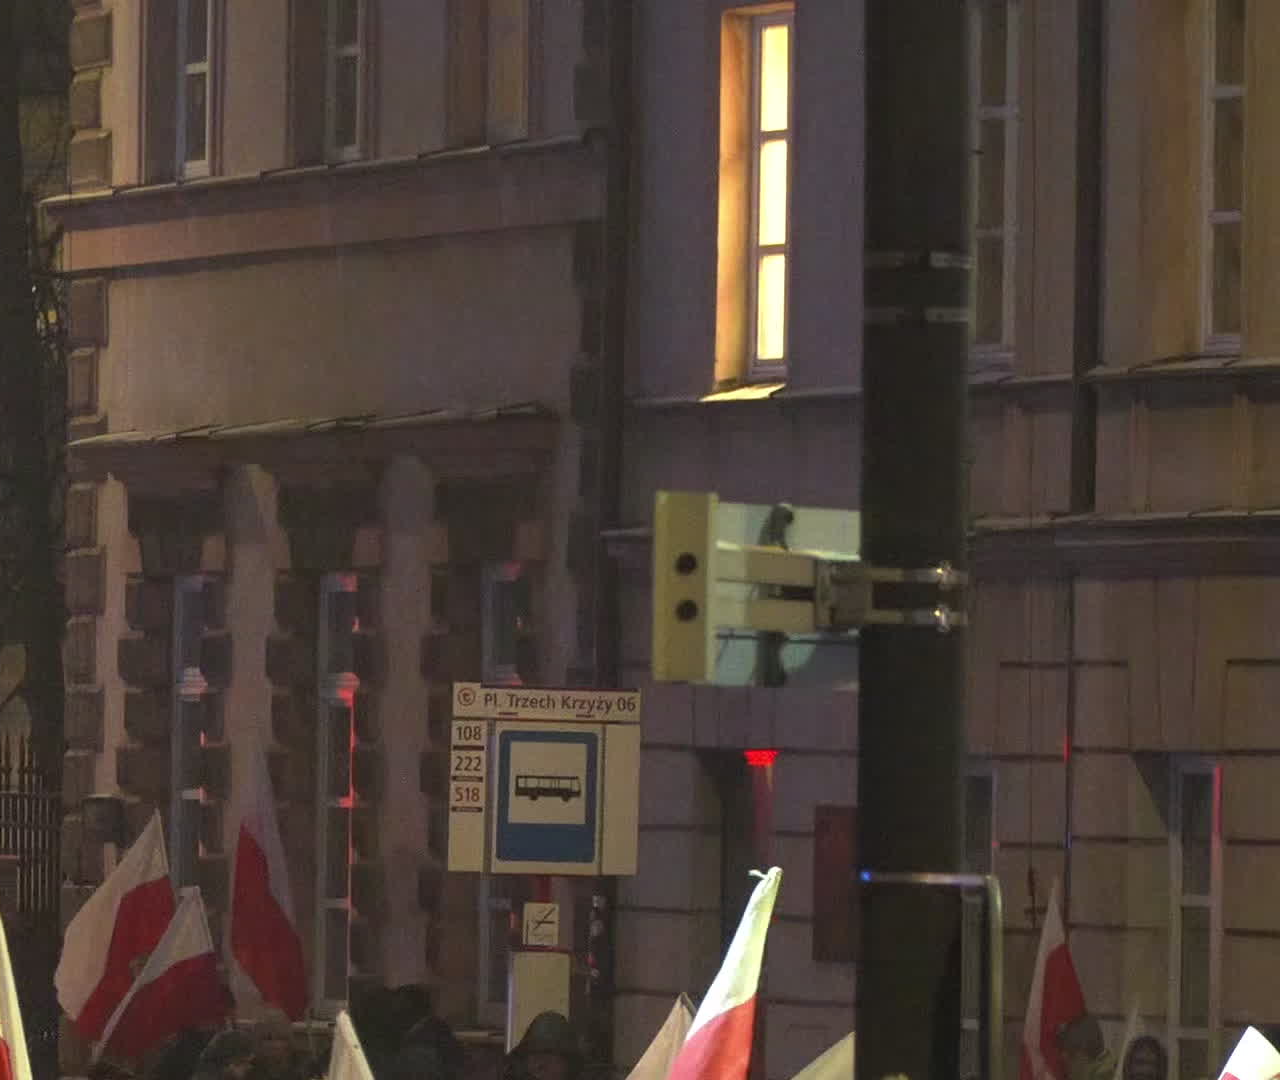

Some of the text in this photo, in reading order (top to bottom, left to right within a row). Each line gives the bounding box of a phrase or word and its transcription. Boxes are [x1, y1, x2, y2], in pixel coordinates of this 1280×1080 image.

[506, 694, 556, 709] Trzech
[561, 696, 614, 713] Krzyży
[617, 697, 637, 713] 06
[456, 726, 481, 741] 108
[455, 756, 481, 771] 222
[455, 787, 480, 802] 518
